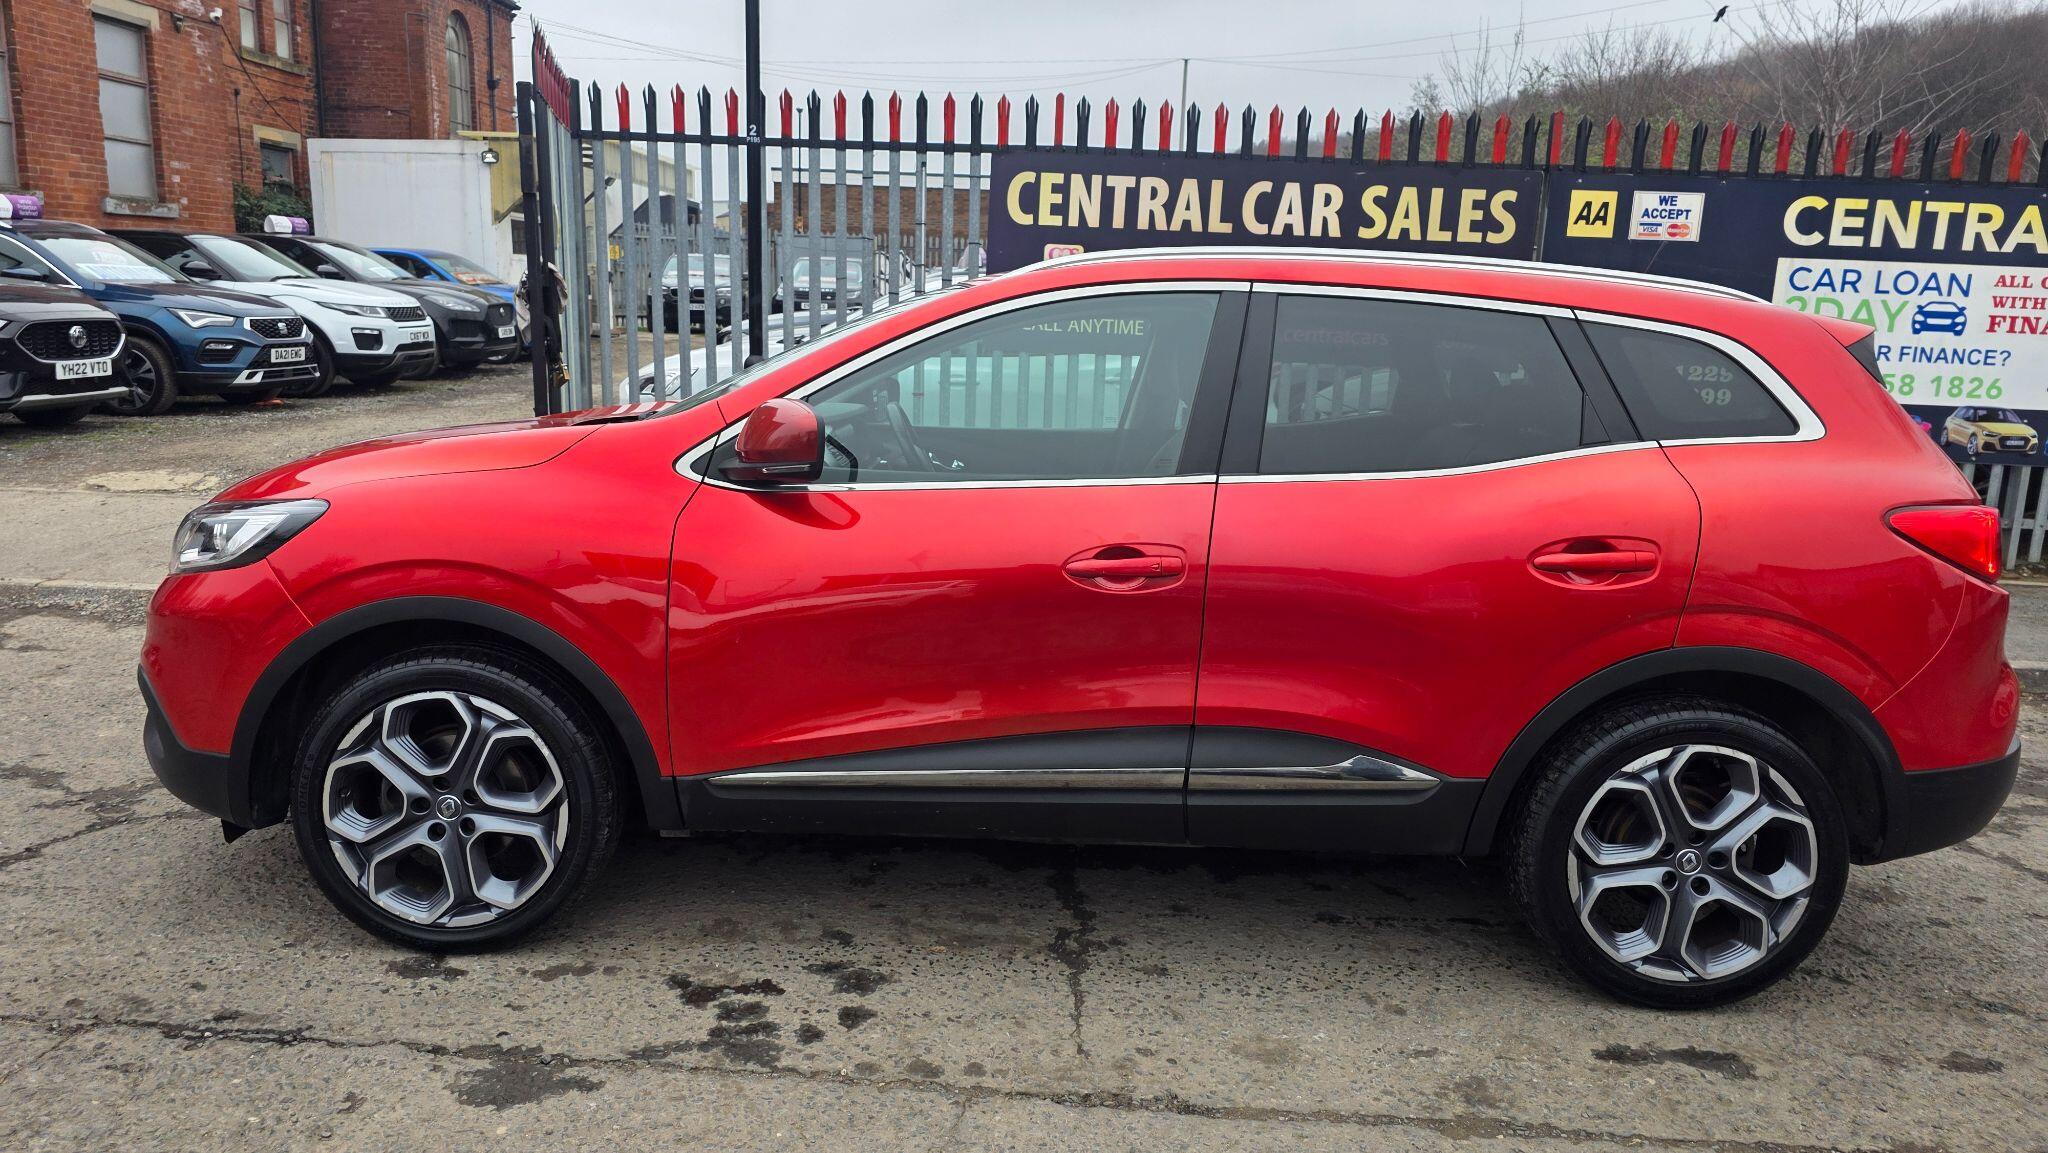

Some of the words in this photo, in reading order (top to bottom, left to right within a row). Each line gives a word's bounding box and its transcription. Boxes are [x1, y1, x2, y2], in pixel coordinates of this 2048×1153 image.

[749, 124, 757, 135] 2
[1006, 171, 1233, 233] CENTRAL
[1241, 180, 1345, 238] CAR
[1357, 184, 1519, 245] SALES
[1659, 195, 1678, 207] WE
[1573, 201, 1610, 226] AA
[1641, 208, 1692, 220] ACCEPT
[1783, 195, 2048, 254] CENTRA
[1788, 266, 1862, 293] CAR
[1874, 270, 1973, 298] LOAN
[1993, 274, 2034, 289] ALL
[1992, 295, 2048, 310] WITH
[1067, 318, 1144, 336] ANYTIME
[275, 349, 290, 361] DA21
[1898, 346, 2012, 367] FINANCE?
[61, 362, 88, 377] YH22
[90, 360, 108, 374] VTO
[1930, 375, 2003, 400] 1826
